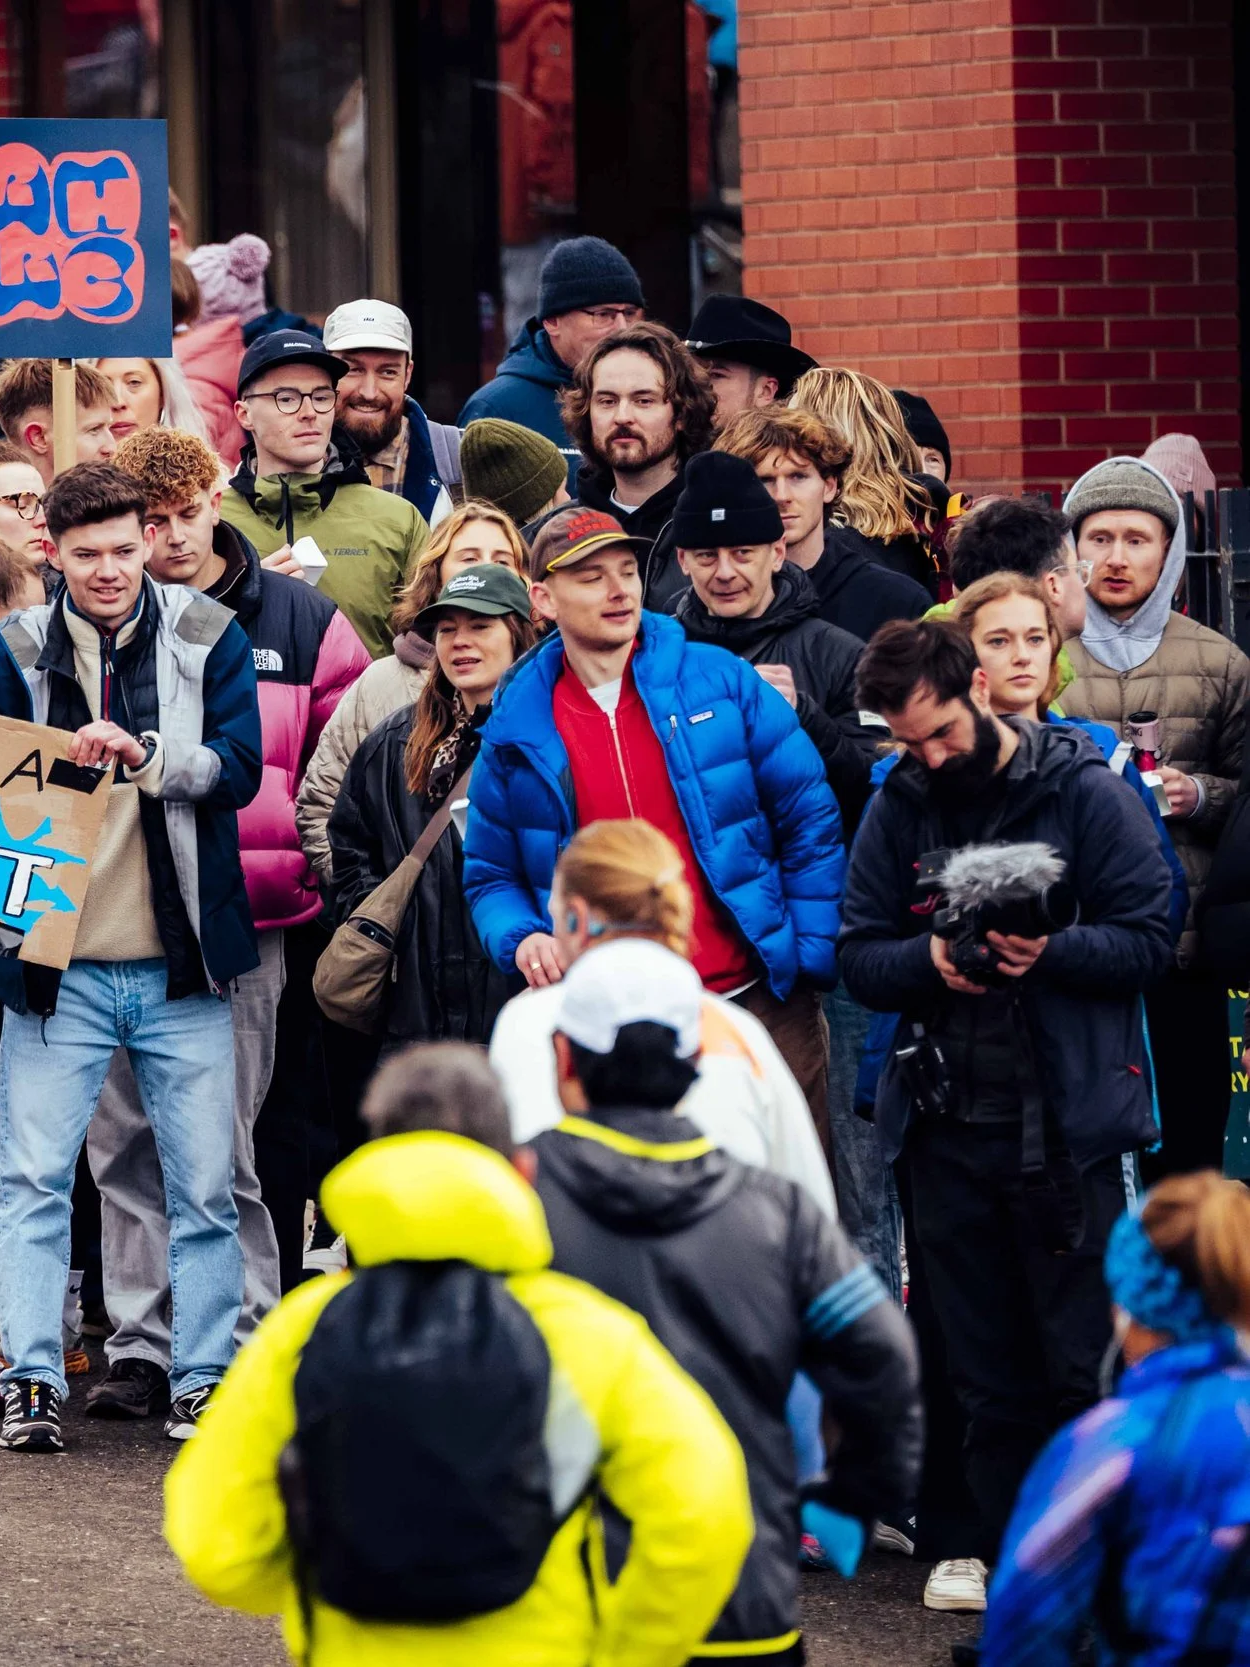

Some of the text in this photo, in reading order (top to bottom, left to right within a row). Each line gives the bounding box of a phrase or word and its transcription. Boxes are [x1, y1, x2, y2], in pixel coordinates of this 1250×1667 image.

[333, 547, 369, 556] TERREX
[251, 648, 269, 656] THE
[0, 749, 44, 792] A
